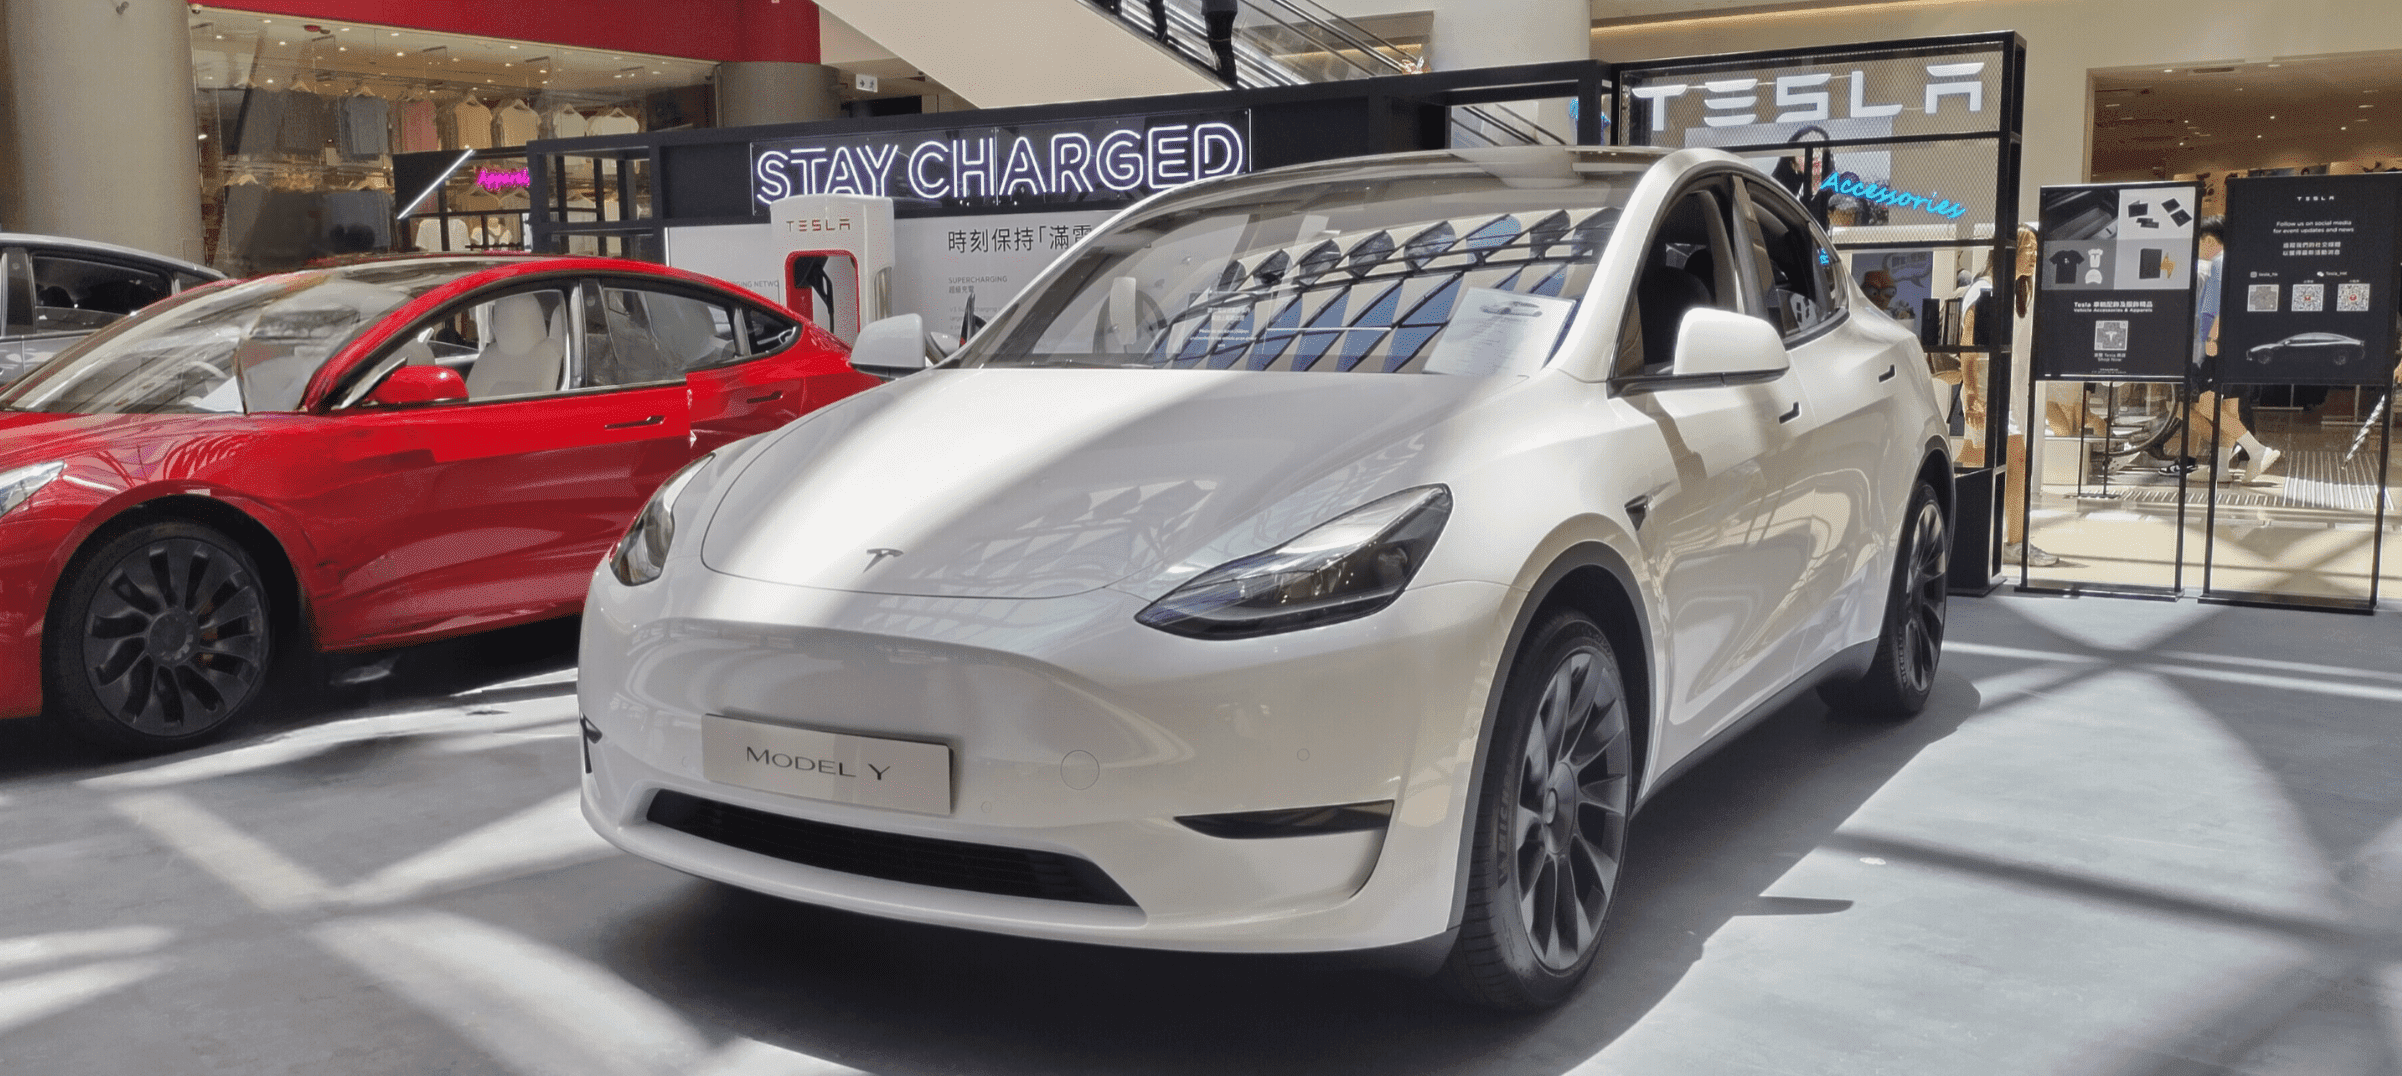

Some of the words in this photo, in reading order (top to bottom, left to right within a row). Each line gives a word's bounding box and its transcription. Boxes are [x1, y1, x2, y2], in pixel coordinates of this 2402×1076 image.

[1632, 62, 1985, 132] TESLA
[757, 143, 899, 204] STAY
[908, 122, 1244, 199] CHARGED
[1820, 171, 1967, 219] Accessories
[786, 218, 851, 232] TESLA
[949, 275, 1008, 284] SUPERCHARGING
[746, 746, 857, 778] MODEL
[868, 763, 891, 781] Y
